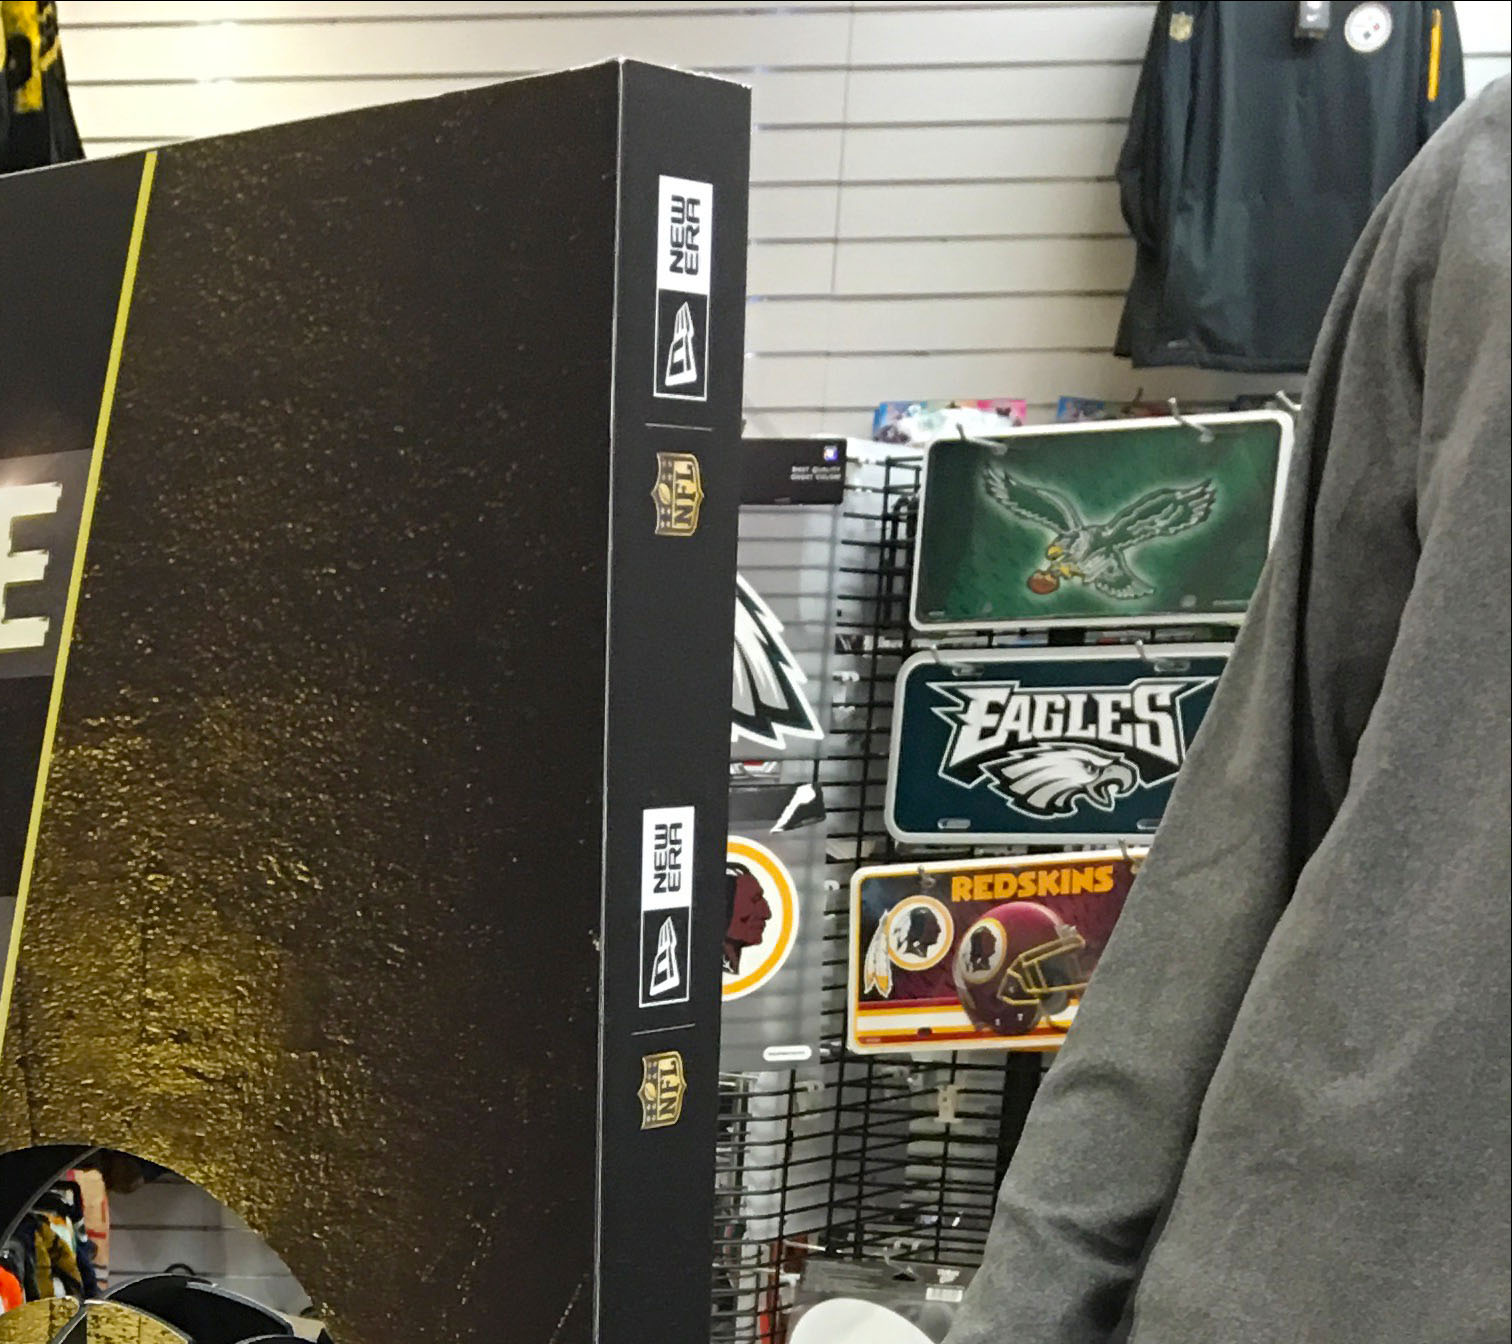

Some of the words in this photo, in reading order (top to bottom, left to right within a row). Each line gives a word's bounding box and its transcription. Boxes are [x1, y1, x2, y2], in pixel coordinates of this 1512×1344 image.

[669, 194, 686, 274] NEW
[686, 197, 701, 276] ERA
[952, 679, 1183, 766] EAGLES
[653, 822, 669, 894] NEW
[668, 822, 683, 893] ERA
[950, 865, 1114, 903] REDSKINS
